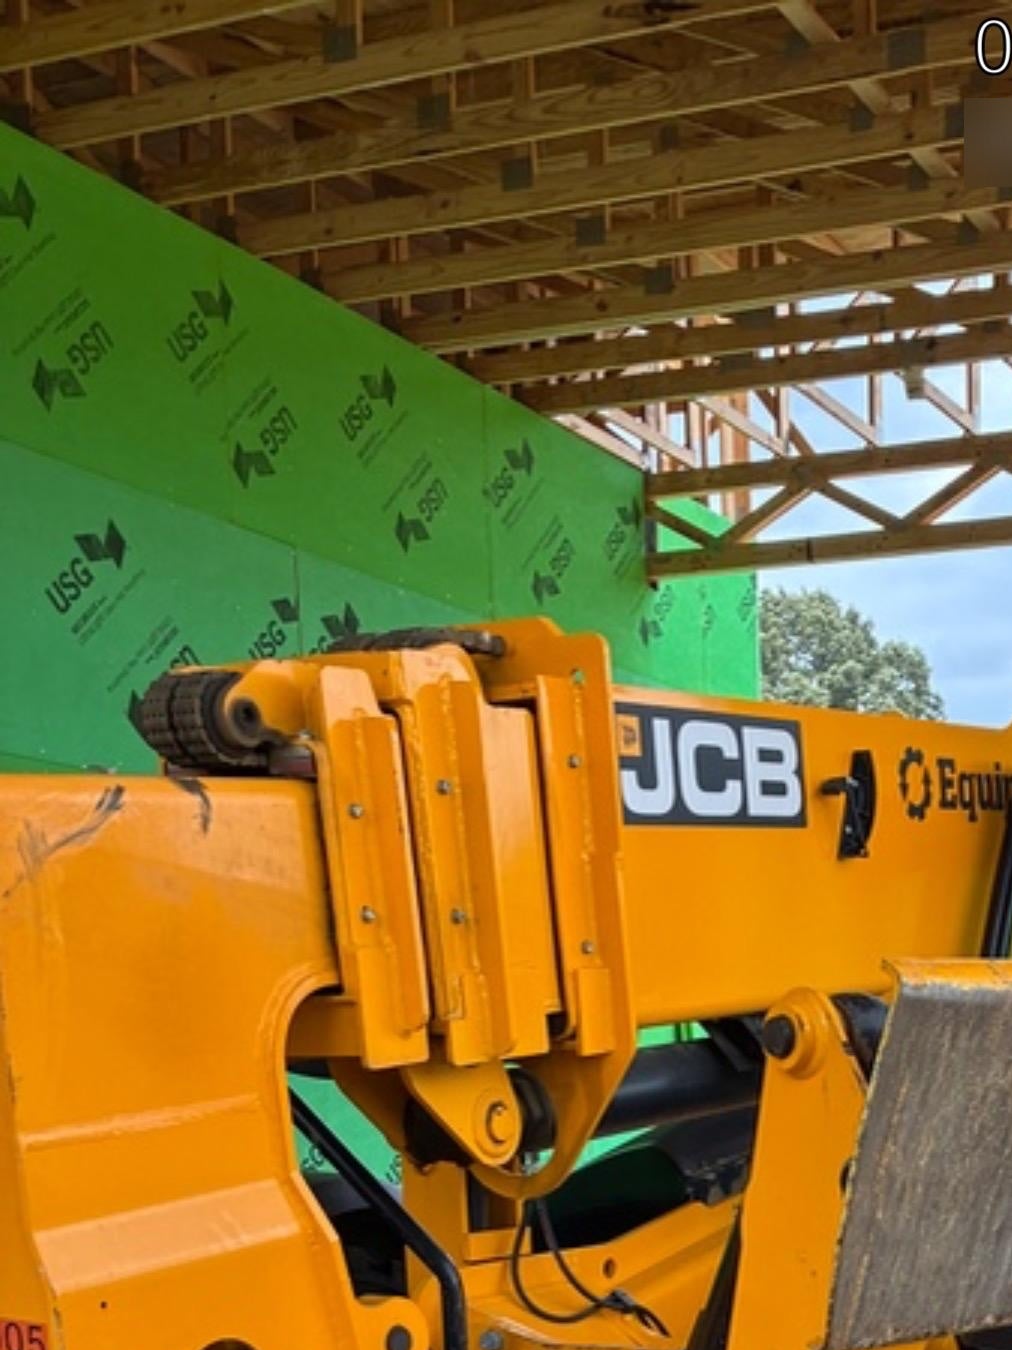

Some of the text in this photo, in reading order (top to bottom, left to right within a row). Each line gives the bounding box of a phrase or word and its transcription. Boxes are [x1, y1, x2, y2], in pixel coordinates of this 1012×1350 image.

[66, 320, 114, 377] USG
[165, 311, 209, 364] USG
[259, 405, 298, 456] USG
[338, 393, 373, 442] USG
[418, 478, 449, 522] USG
[45, 557, 94, 615] USG
[620, 717, 802, 817] JCB
